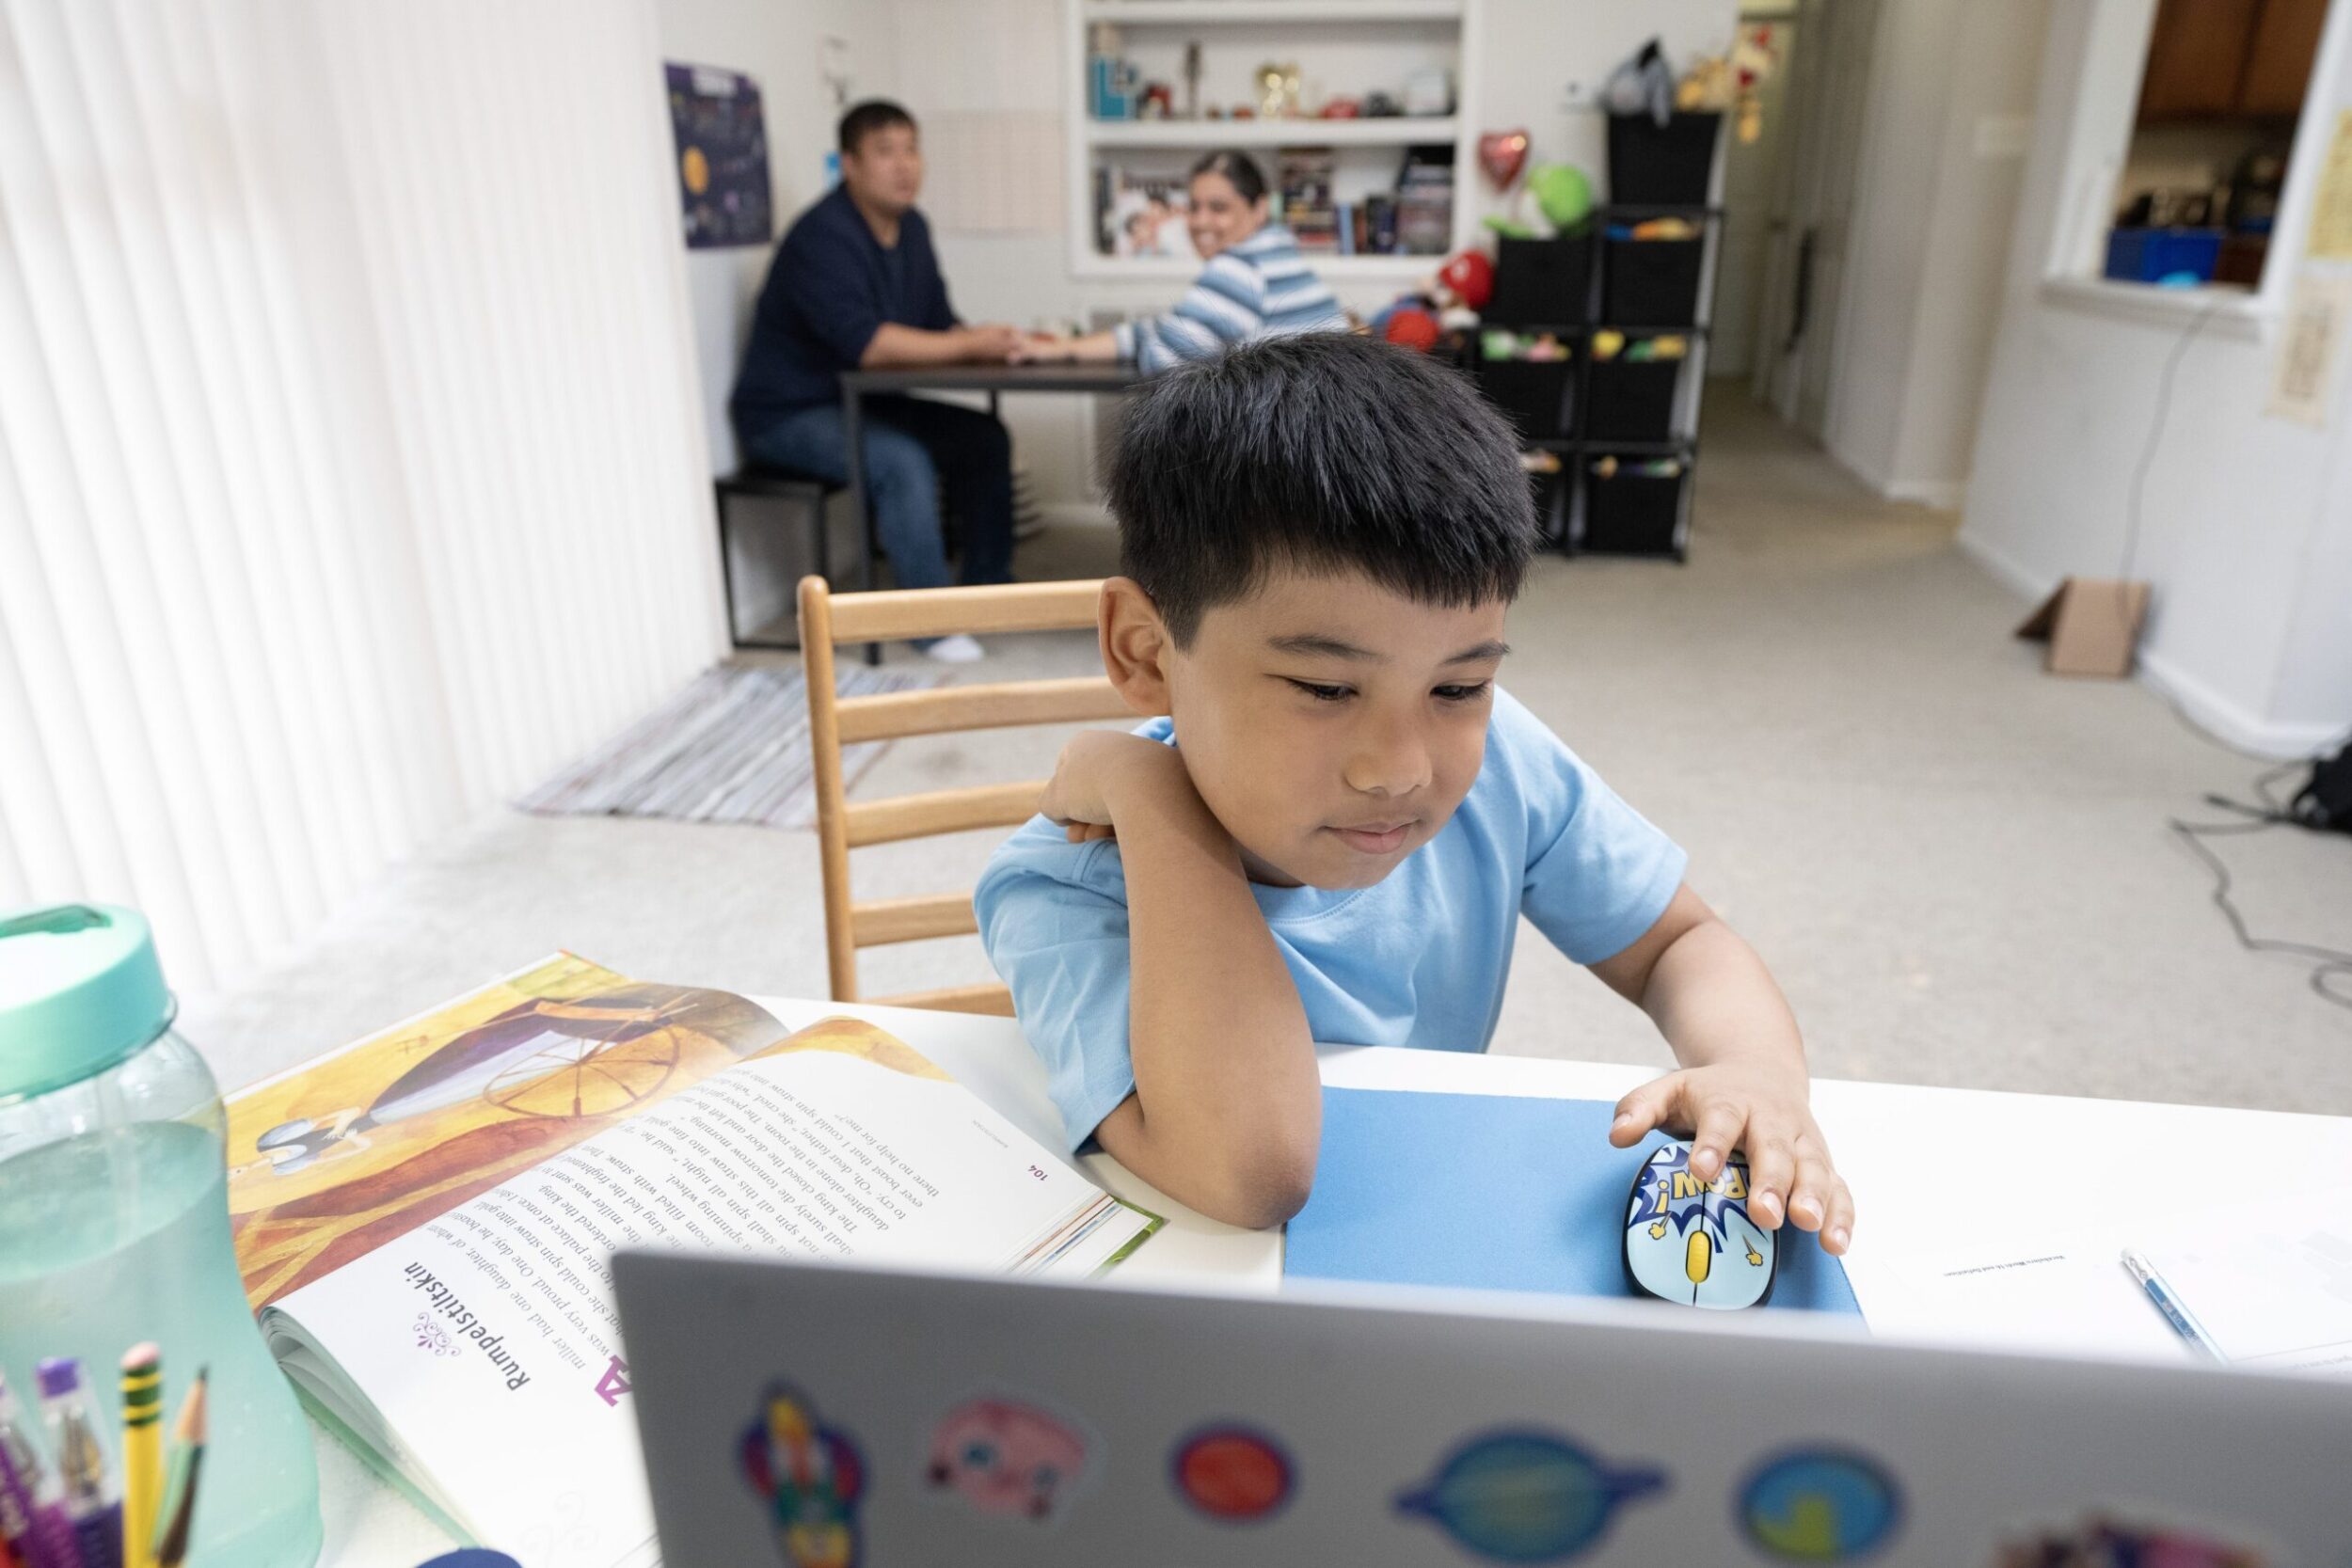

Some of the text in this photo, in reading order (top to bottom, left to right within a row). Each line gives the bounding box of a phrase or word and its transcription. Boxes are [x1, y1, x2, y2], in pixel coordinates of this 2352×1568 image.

[769, 1085, 796, 1101] straw
[743, 1109, 762, 1124] The
[777, 1111, 796, 1124] she
[795, 1101, 817, 1117] spin
[722, 1117, 746, 1133] and
[764, 1121, 790, 1145] room.
[813, 1117, 843, 1140] could
[651, 1139, 676, 1154] said
[688, 1139, 710, 1157] into
[743, 1133, 768, 1151] door
[860, 1132, 877, 1145] for
[767, 1152, 785, 1167] the
[788, 1144, 806, 1160] the
[849, 1147, 872, 1165] that
[875, 1144, 898, 1164] help
[708, 1156, 739, 1180] straw
[730, 1148, 778, 1189] tomorrow
[828, 1154, 852, 1173] dear
[1027, 1164, 1048, 1181] 104
[550, 1170, 574, 1183] sent
[633, 1174, 657, 1195] with
[781, 1166, 815, 1193] closed
[816, 1168, 845, 1193] alone
[871, 1165, 899, 1191] boast
[912, 1175, 939, 1196] there
[571, 1182, 592, 1198] was
[608, 1182, 627, 1197] the
[665, 1173, 698, 1202] wheel.
[707, 1183, 726, 1197] all
[737, 1180, 758, 1199] this
[777, 1188, 795, 1203] die
[517, 1196, 542, 1215] once.
[622, 1196, 644, 1213] led
[654, 1195, 685, 1220] filled
[755, 1199, 774, 1212] all
[814, 1192, 838, 1215] king
[875, 1193, 894, 1209] cry.
[898, 1189, 923, 1207] ever
[559, 1201, 579, 1217] the
[591, 1197, 624, 1225] miller
[726, 1198, 750, 1219] spin
[793, 1204, 827, 1231] surely
[842, 1193, 888, 1230] daughter
[495, 1211, 517, 1227] into
[642, 1211, 667, 1235] king
[697, 1200, 742, 1243] spinning
[775, 1213, 800, 1235] spin
[836, 1213, 857, 1233] The
[513, 1225, 542, 1247] straw
[550, 1224, 589, 1255] palace
[573, 1215, 615, 1250] ordered
[622, 1225, 641, 1243] the
[666, 1234, 685, 1249] he
[685, 1220, 713, 1246] room
[746, 1220, 776, 1244] shall
[491, 1236, 513, 1255] day,
[776, 1244, 791, 1257] ou
[797, 1235, 818, 1253] not
[823, 1231, 853, 1254] shall
[511, 1255, 533, 1276] One
[539, 1246, 564, 1268] spin
[581, 1254, 602, 1272] the
[466, 1247, 511, 1289] daughter,
[557, 1267, 589, 1295] could
[509, 1291, 532, 1311] one
[531, 1275, 570, 1309] proud.
[587, 1295, 609, 1314] she
[405, 1261, 531, 1391] Rumpelstiltskin
[527, 1312, 554, 1338] had
[564, 1310, 588, 1334] very
[551, 1338, 585, 1369] miller
[586, 1333, 609, 1355] was
[595, 1354, 633, 1407] A
